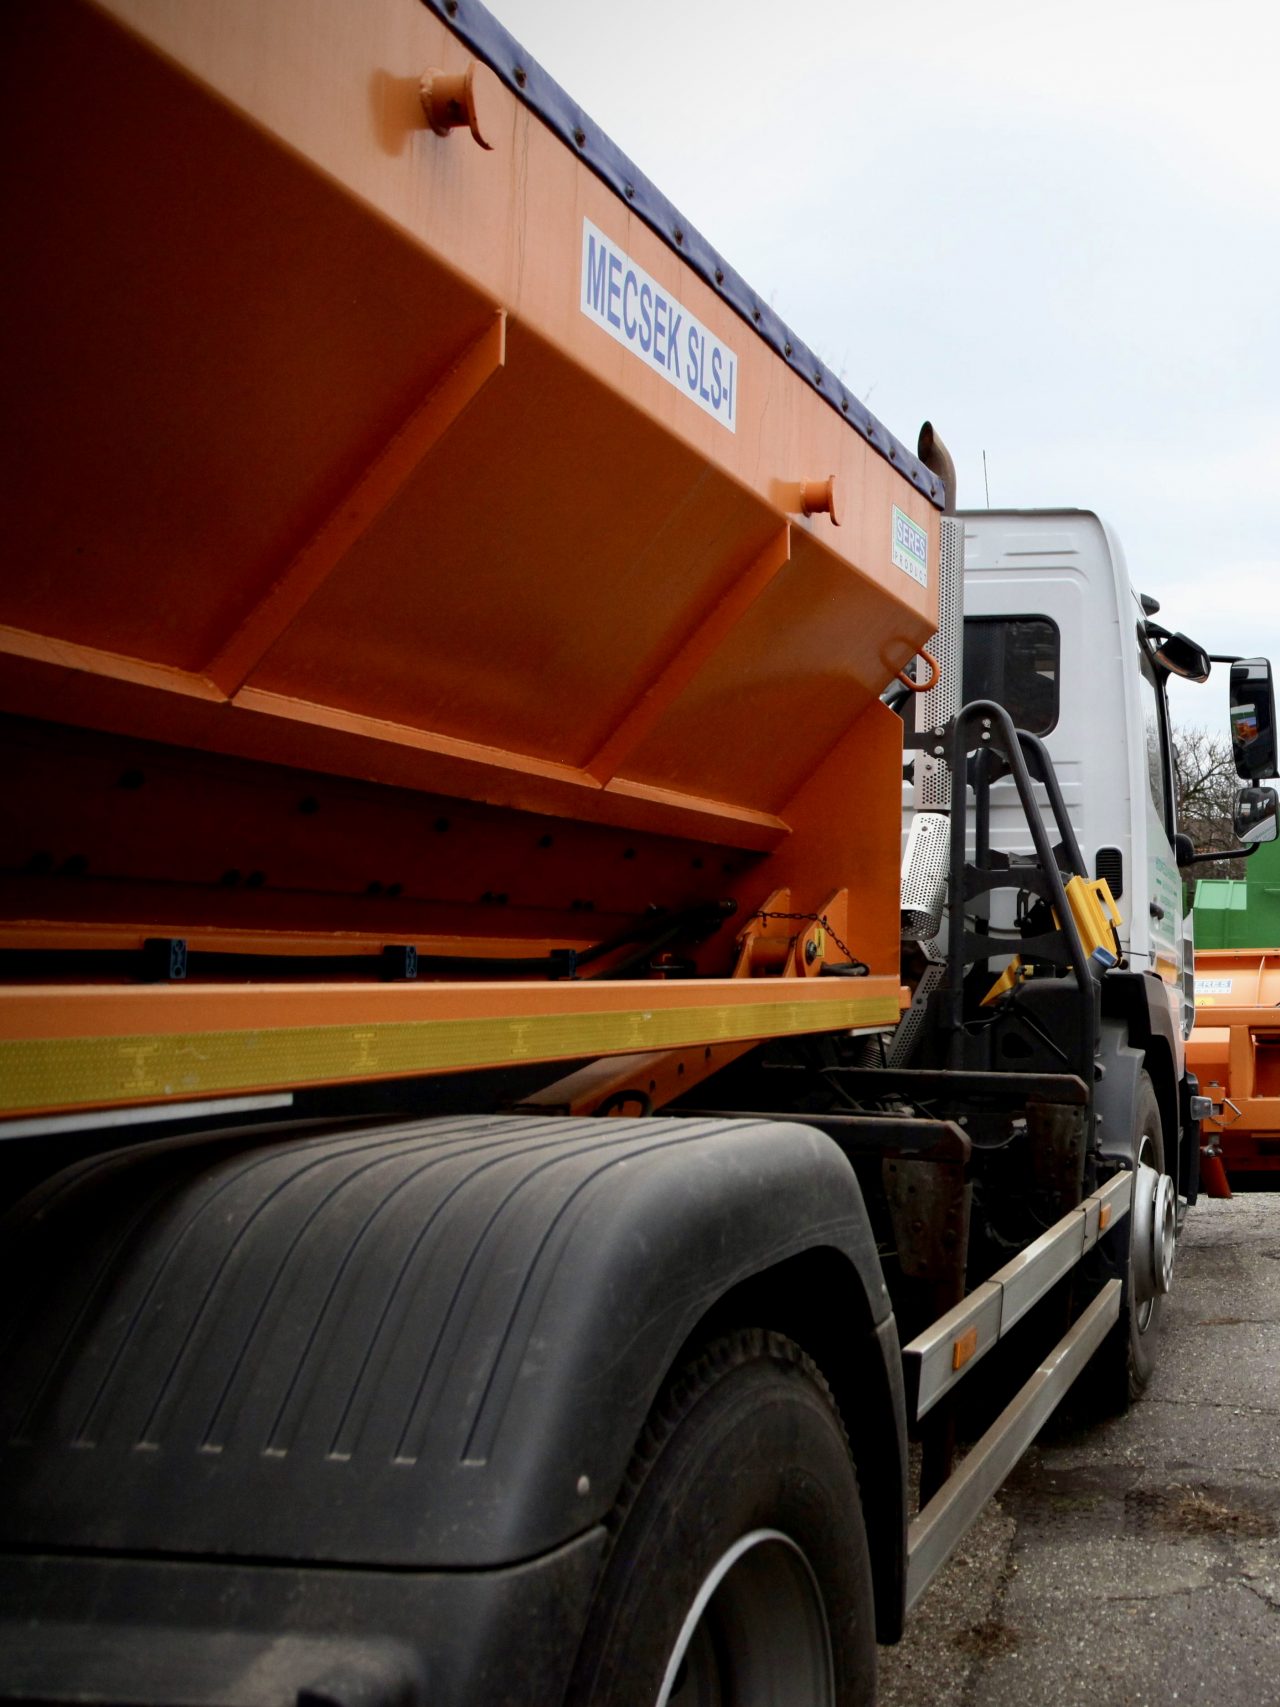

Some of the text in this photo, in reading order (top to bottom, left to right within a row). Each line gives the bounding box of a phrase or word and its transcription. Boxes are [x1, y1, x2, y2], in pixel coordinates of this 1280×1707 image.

[587, 234, 734, 420] MECSEK SLS-I
[897, 518, 926, 561] SERES
